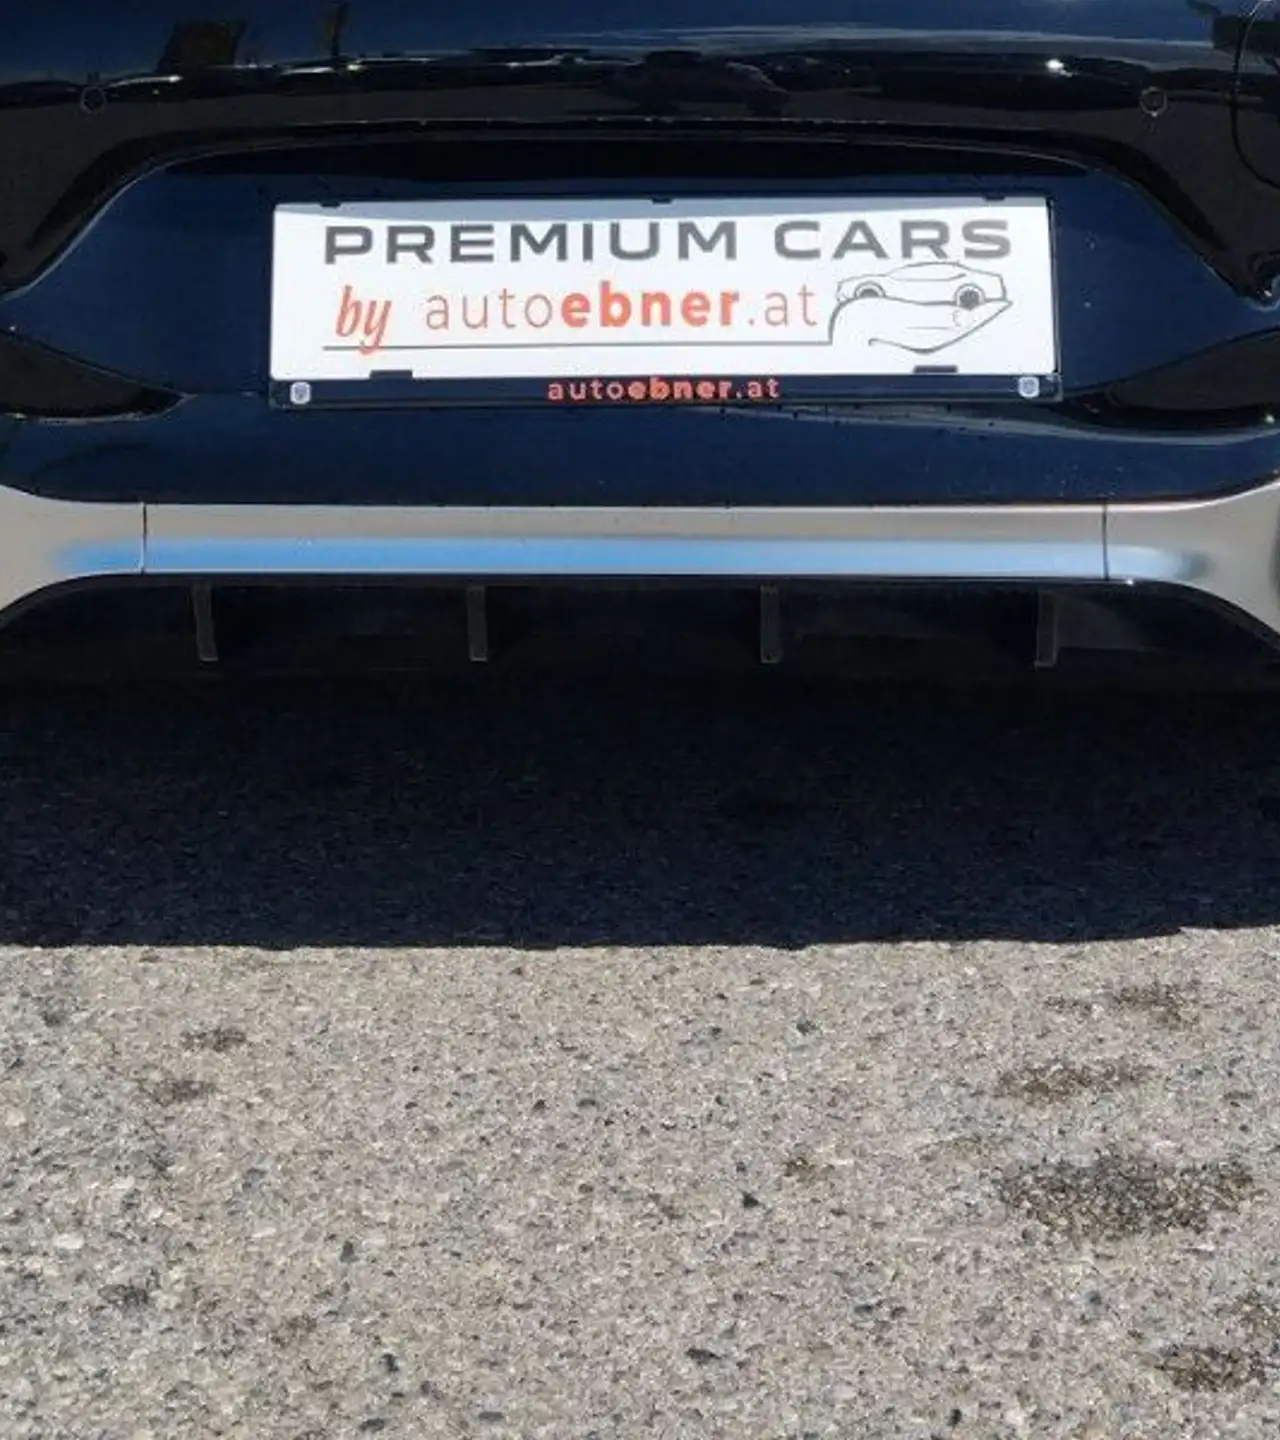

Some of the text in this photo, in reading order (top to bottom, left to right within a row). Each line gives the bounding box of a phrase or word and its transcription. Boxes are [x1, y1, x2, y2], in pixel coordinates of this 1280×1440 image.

[324, 218, 1012, 265] PREMIUM CARS
[334, 279, 819, 355] by autoebner.at
[547, 376, 781, 402] autoebner.at
